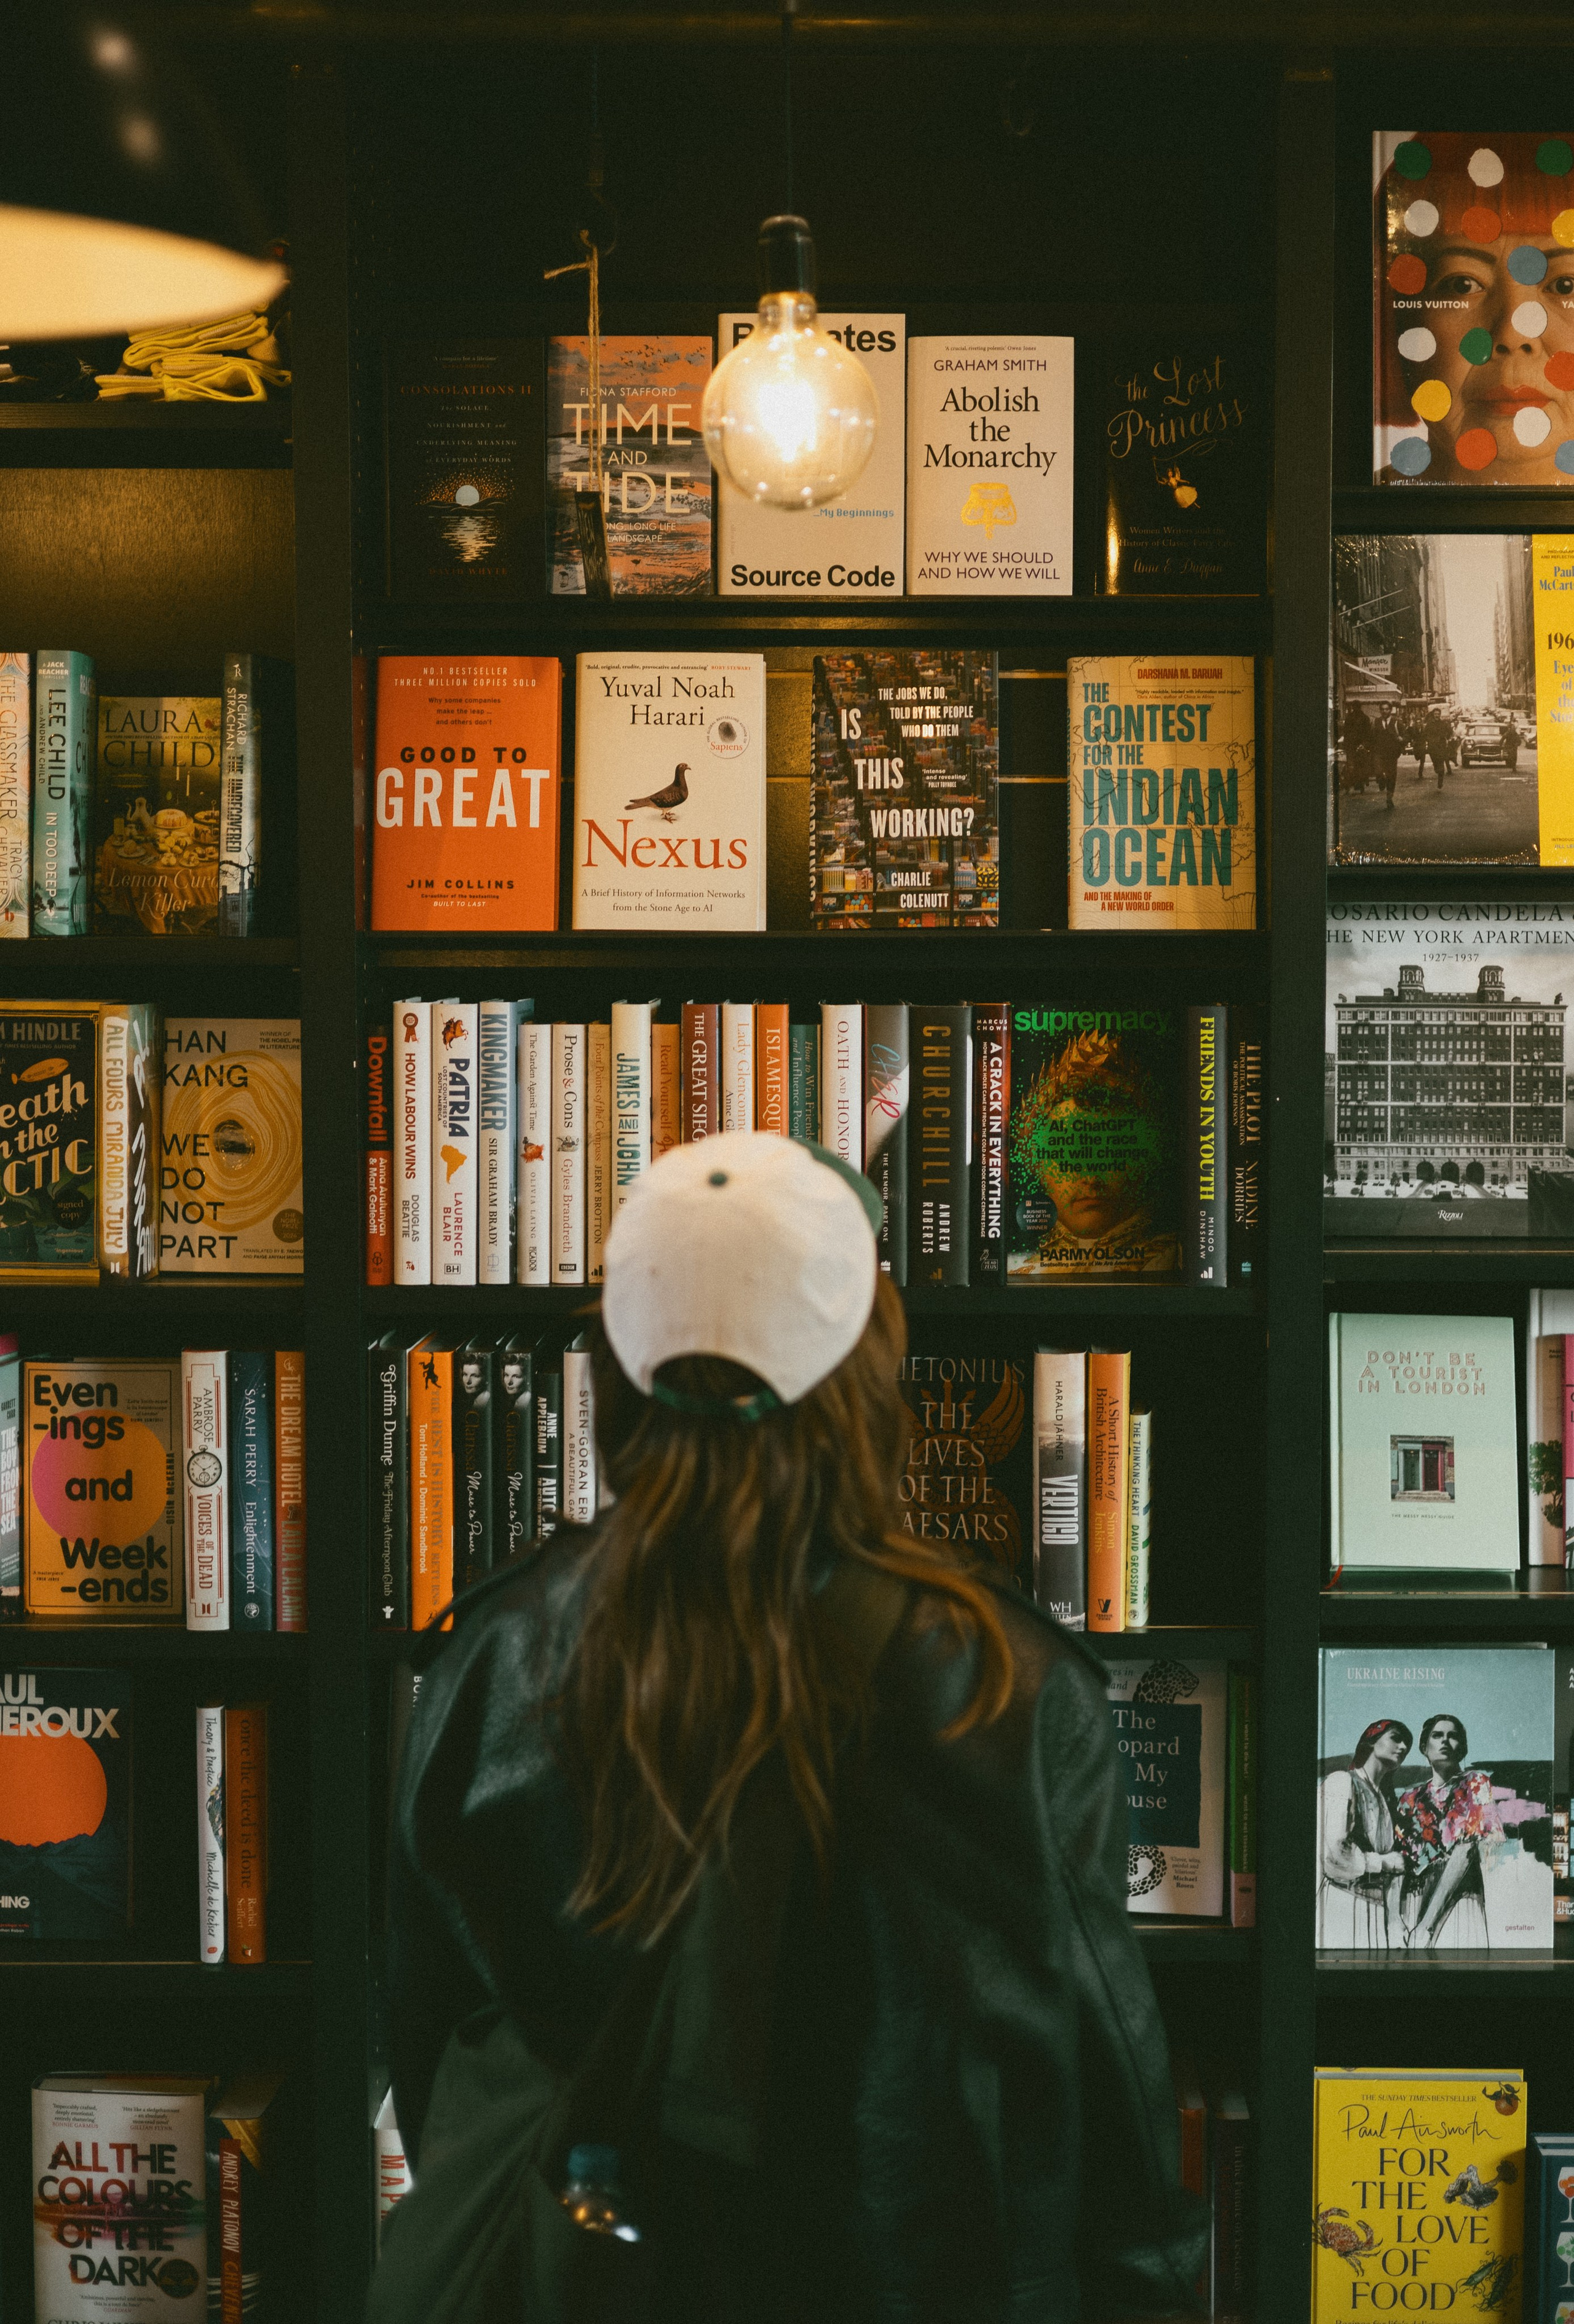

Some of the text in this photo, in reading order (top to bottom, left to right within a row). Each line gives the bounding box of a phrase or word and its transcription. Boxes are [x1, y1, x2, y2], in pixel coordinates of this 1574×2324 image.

[934, 360, 1046, 371] GRAHAM SMITH
[941, 387, 1040, 413] Abolish
[563, 403, 692, 445] TIME
[969, 417, 1010, 442] the
[608, 451, 647, 465] AND
[923, 443, 1056, 476] Monarchy
[564, 472, 690, 513] TIDE
[837, 508, 894, 518] Beginnings
[925, 552, 1053, 563] WHY WE SHOULD
[731, 565, 895, 587] Source Code
[919, 568, 1059, 579] AND HOW WE WILL
[600, 676, 735, 699] Yuval Noah
[1083, 683, 1109, 703] THE
[105, 710, 202, 733] LAURA
[630, 705, 705, 726] Harari
[841, 708, 861, 739] IS
[1083, 704, 1211, 743] CONTEST
[47, 689, 66, 800] LEE CHILD
[401, 747, 527, 763] GOOD TO
[710, 741, 743, 753] Sapiens
[1083, 745, 1144, 765] FOR THE
[855, 757, 903, 789] THIS
[377, 768, 550, 828] GREAT
[1083, 769, 1238, 826] INDIAN
[871, 808, 975, 838] WORKING?
[46, 812, 57, 897] IN TOO DEEP
[582, 820, 748, 869] Nexus
[1083, 828, 1232, 887] OCEAN
[407, 879, 515, 889] JIM COLLINS
[582, 888, 745, 899] A Brief History of Information Networks
[891, 872, 931, 887] CHARLIE
[613, 903, 631, 912] from
[634, 903, 646, 912] the
[649, 904, 671, 912] Stone
[674, 904, 690, 914] Age
[703, 904, 713, 912] AI
[900, 893, 948, 907] COLENUTT
[164, 1030, 226, 1053] HAN
[837, 1021, 849, 1069] OATH
[163, 1064, 248, 1088] KANG
[481, 1014, 507, 1131] KINGMAKER
[564, 1034, 577, 1128] Prose & Cons
[369, 1037, 387, 1141] Downfall
[449, 1059, 470, 1137] PATRIA
[405, 1053, 416, 1179] HOW LABOUR WINS
[922, 1025, 951, 1187] CHURCHILL
[1200, 1016, 1214, 1200] FRIENDS IN YOUTH
[105, 1024, 124, 1249] ALL FOURS MIRANDA JULY
[837, 1099, 849, 1160] HONOR
[988, 1042, 1002, 1239] A CRACK IN EVERYTHING
[162, 1134, 209, 1156] WE
[161, 1168, 205, 1190] DO
[161, 1201, 224, 1224] NOT
[922, 1202, 933, 1254] ROBERTS
[939, 1204, 949, 1252] ANDREW
[160, 1236, 237, 1259] PART
[1040, 1247, 1145, 1260] PARMY OLSON
[1361, 1366, 1482, 1380] A TOURIST
[1367, 1351, 1475, 1366] DON'T BE
[34, 1375, 118, 1407] Even
[1358, 1380, 1485, 1395] IN LONDON
[34, 1407, 124, 1449] -ings
[381, 1365, 397, 1466] Griffin Dunne
[921, 1402, 974, 1429] THE
[909, 1439, 985, 1467] LIVES
[65, 1469, 133, 1501] and
[243, 1389, 256, 1593] SARAH PERRY Enlightenment
[898, 1477, 995, 1504] OF THE
[1042, 1474, 1078, 1544] VERTIGO
[60, 1536, 167, 1569] Week
[61, 1569, 168, 1602] -ends
[1347, 1667, 1445, 1680] UKRAINE RISING
[202, 1718, 217, 1747] Theory
[1113, 1709, 1157, 1729] The
[205, 1756, 216, 1786] Practice
[1135, 1763, 1168, 1784] My
[1338, 2105, 1501, 2144] Paul Ainsworth
[49, 2141, 177, 2174] ALL THE
[1379, 2148, 1450, 2176] FOR
[38, 2176, 193, 2208] COLOURS
[1352, 2181, 1427, 2210] THE
[58, 2222, 173, 2251] OF THE
[1396, 2216, 1489, 2243] LOVE
[69, 2255, 162, 2286] DARK
[1382, 2249, 1430, 2277] OF
[1351, 2282, 1455, 2310] FOOD
